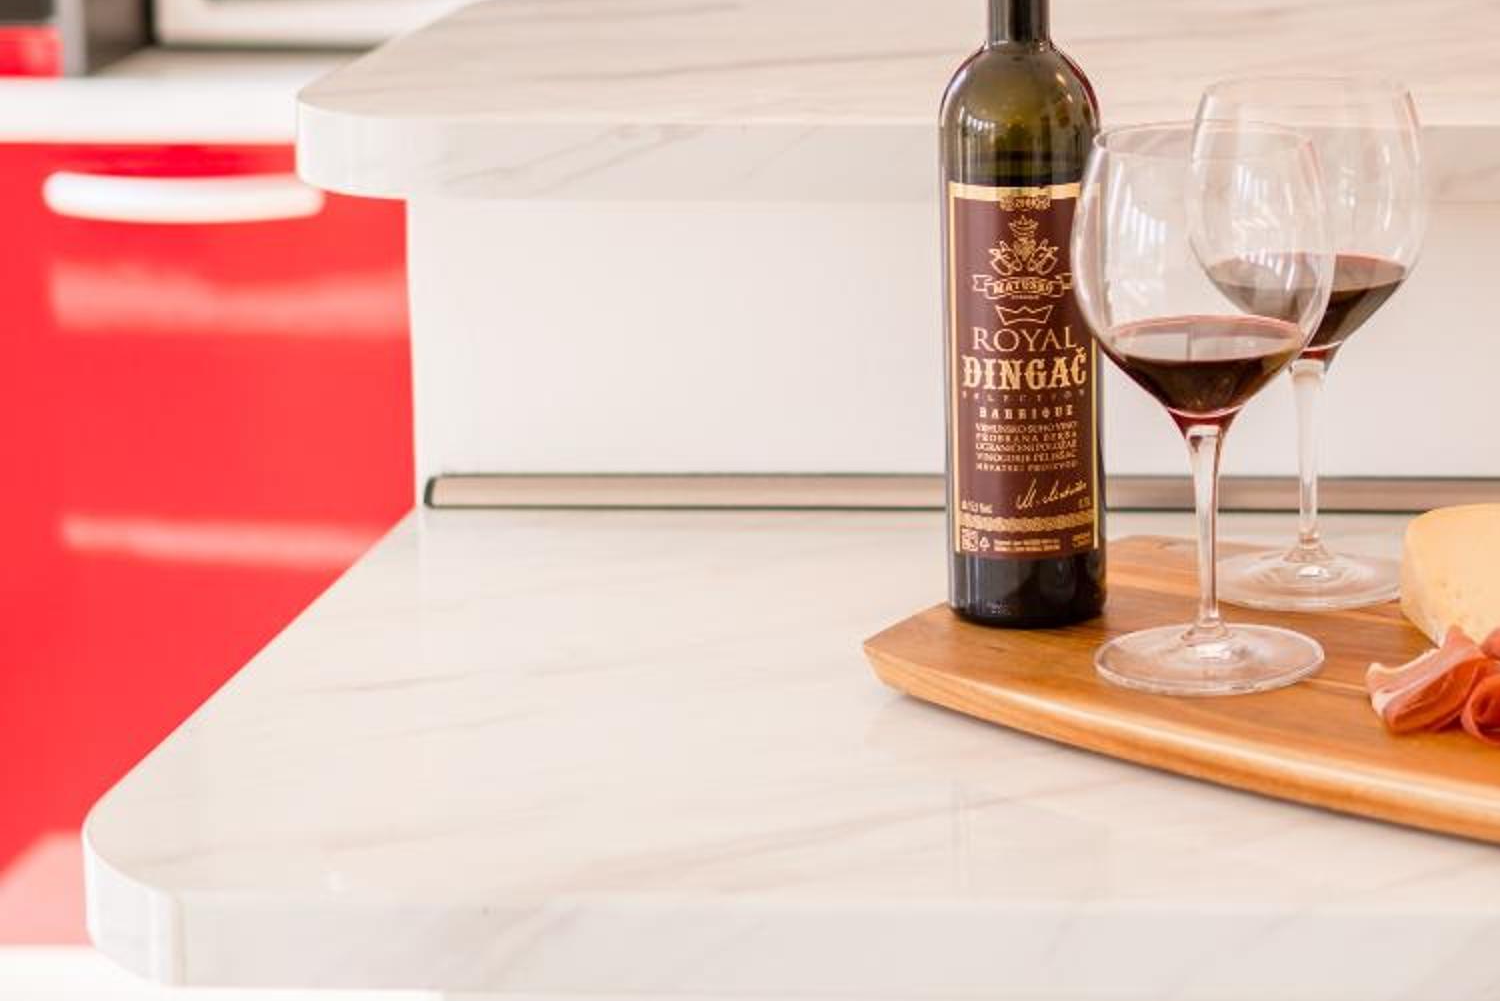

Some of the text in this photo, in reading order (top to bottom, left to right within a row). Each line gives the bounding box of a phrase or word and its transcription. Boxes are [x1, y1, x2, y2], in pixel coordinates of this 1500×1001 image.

[972, 326, 1078, 352] ROYAL
[961, 346, 1088, 390] DINGAČ
[978, 404, 1074, 420] BARRIQUE
